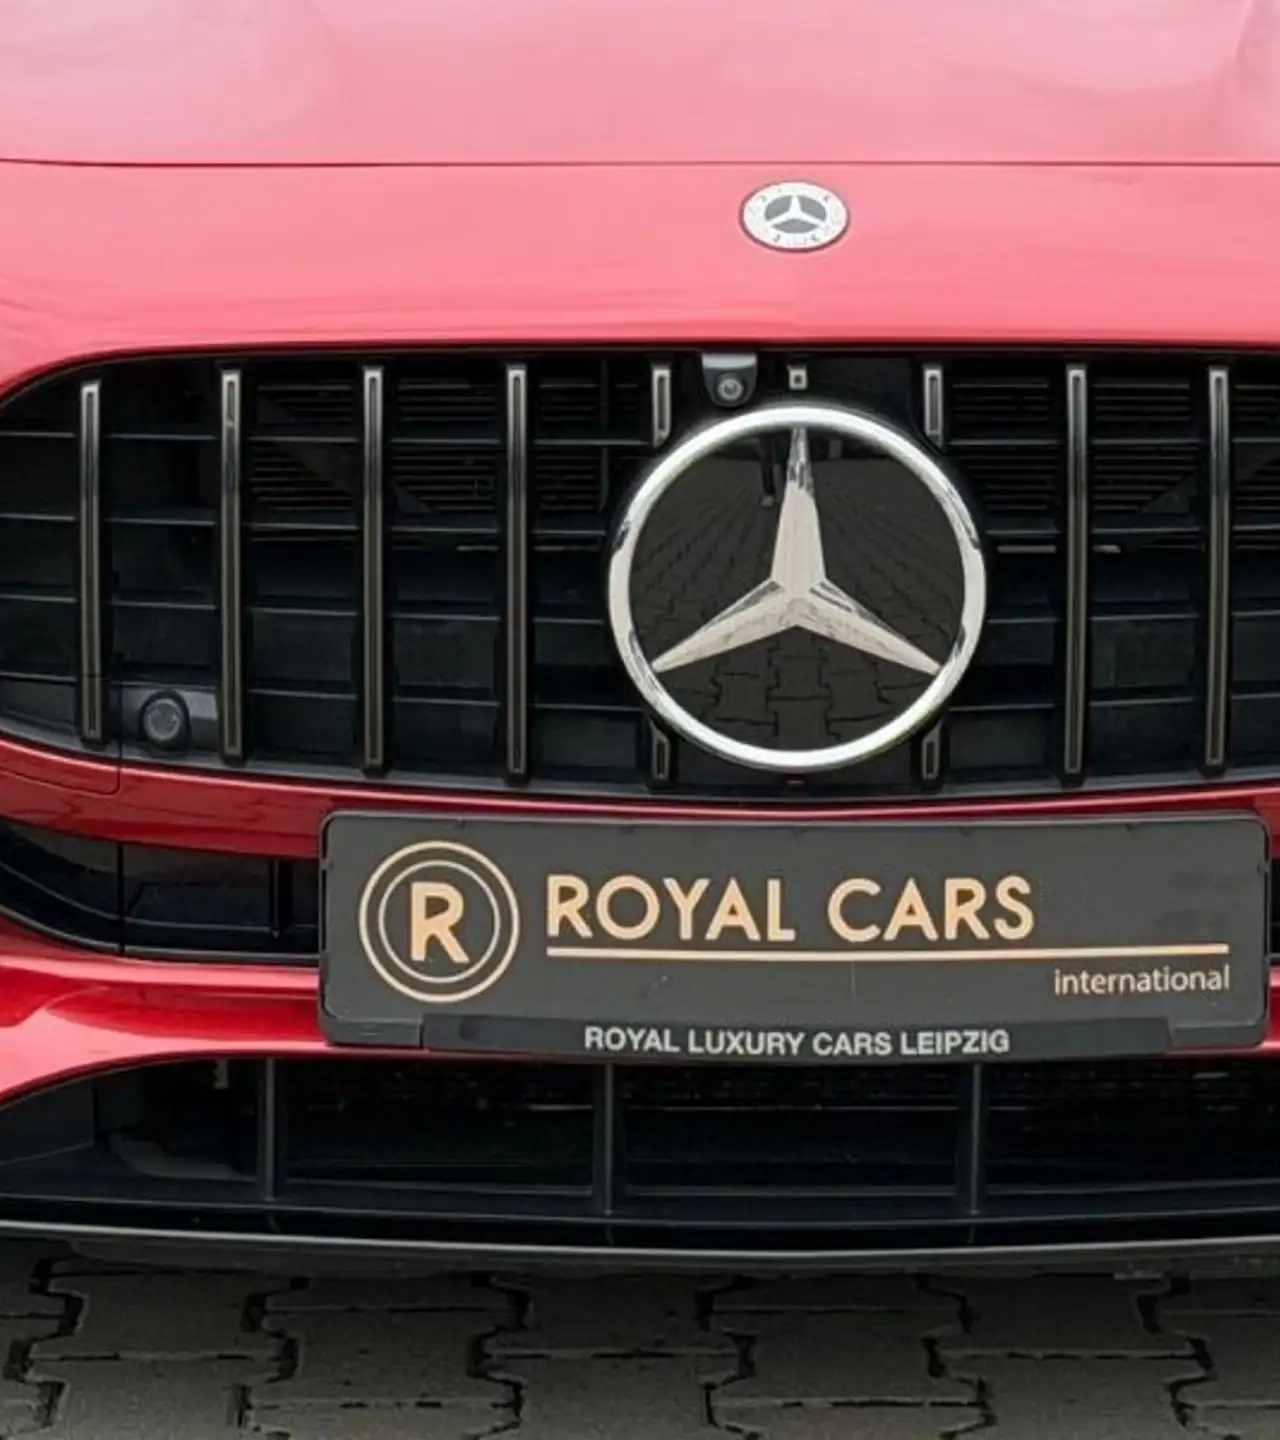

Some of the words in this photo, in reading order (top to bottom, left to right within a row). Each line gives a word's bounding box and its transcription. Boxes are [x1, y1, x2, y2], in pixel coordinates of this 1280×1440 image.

[410, 882, 469, 963] R
[547, 874, 796, 941] ROYAL
[827, 876, 1034, 942] CARS
[1054, 965, 1230, 996] international
[585, 1027, 680, 1053] ROYAL
[688, 1030, 805, 1056] LUXURY
[812, 1031, 892, 1056] CARS
[901, 1029, 1010, 1055] LEIPZIG
